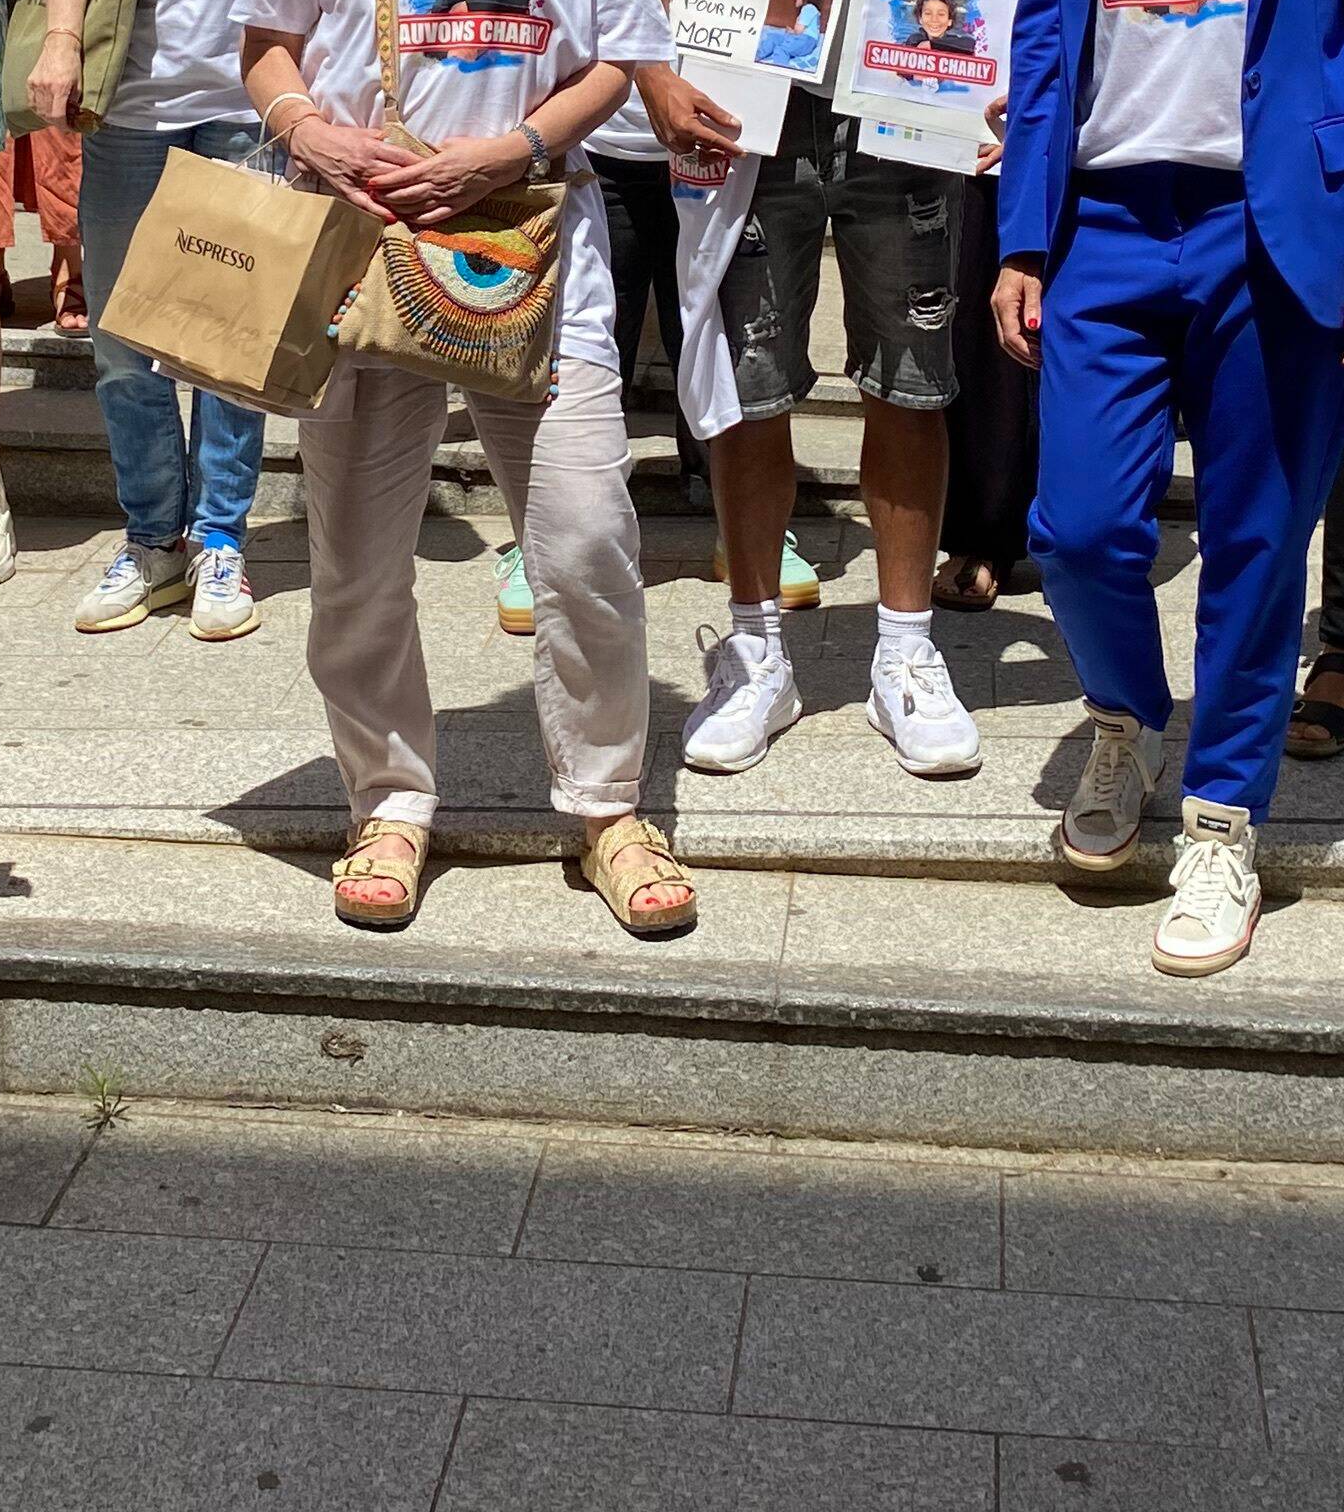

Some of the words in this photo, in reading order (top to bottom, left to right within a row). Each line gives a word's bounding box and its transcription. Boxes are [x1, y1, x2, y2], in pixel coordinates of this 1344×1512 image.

[730, 6, 756, 21] MA
[399, 20, 476, 45] AUVONS
[870, 47, 937, 72] SAUVONS
[938, 57, 992, 80] CHARLY
[174, 226, 256, 273] NESPRESSO
